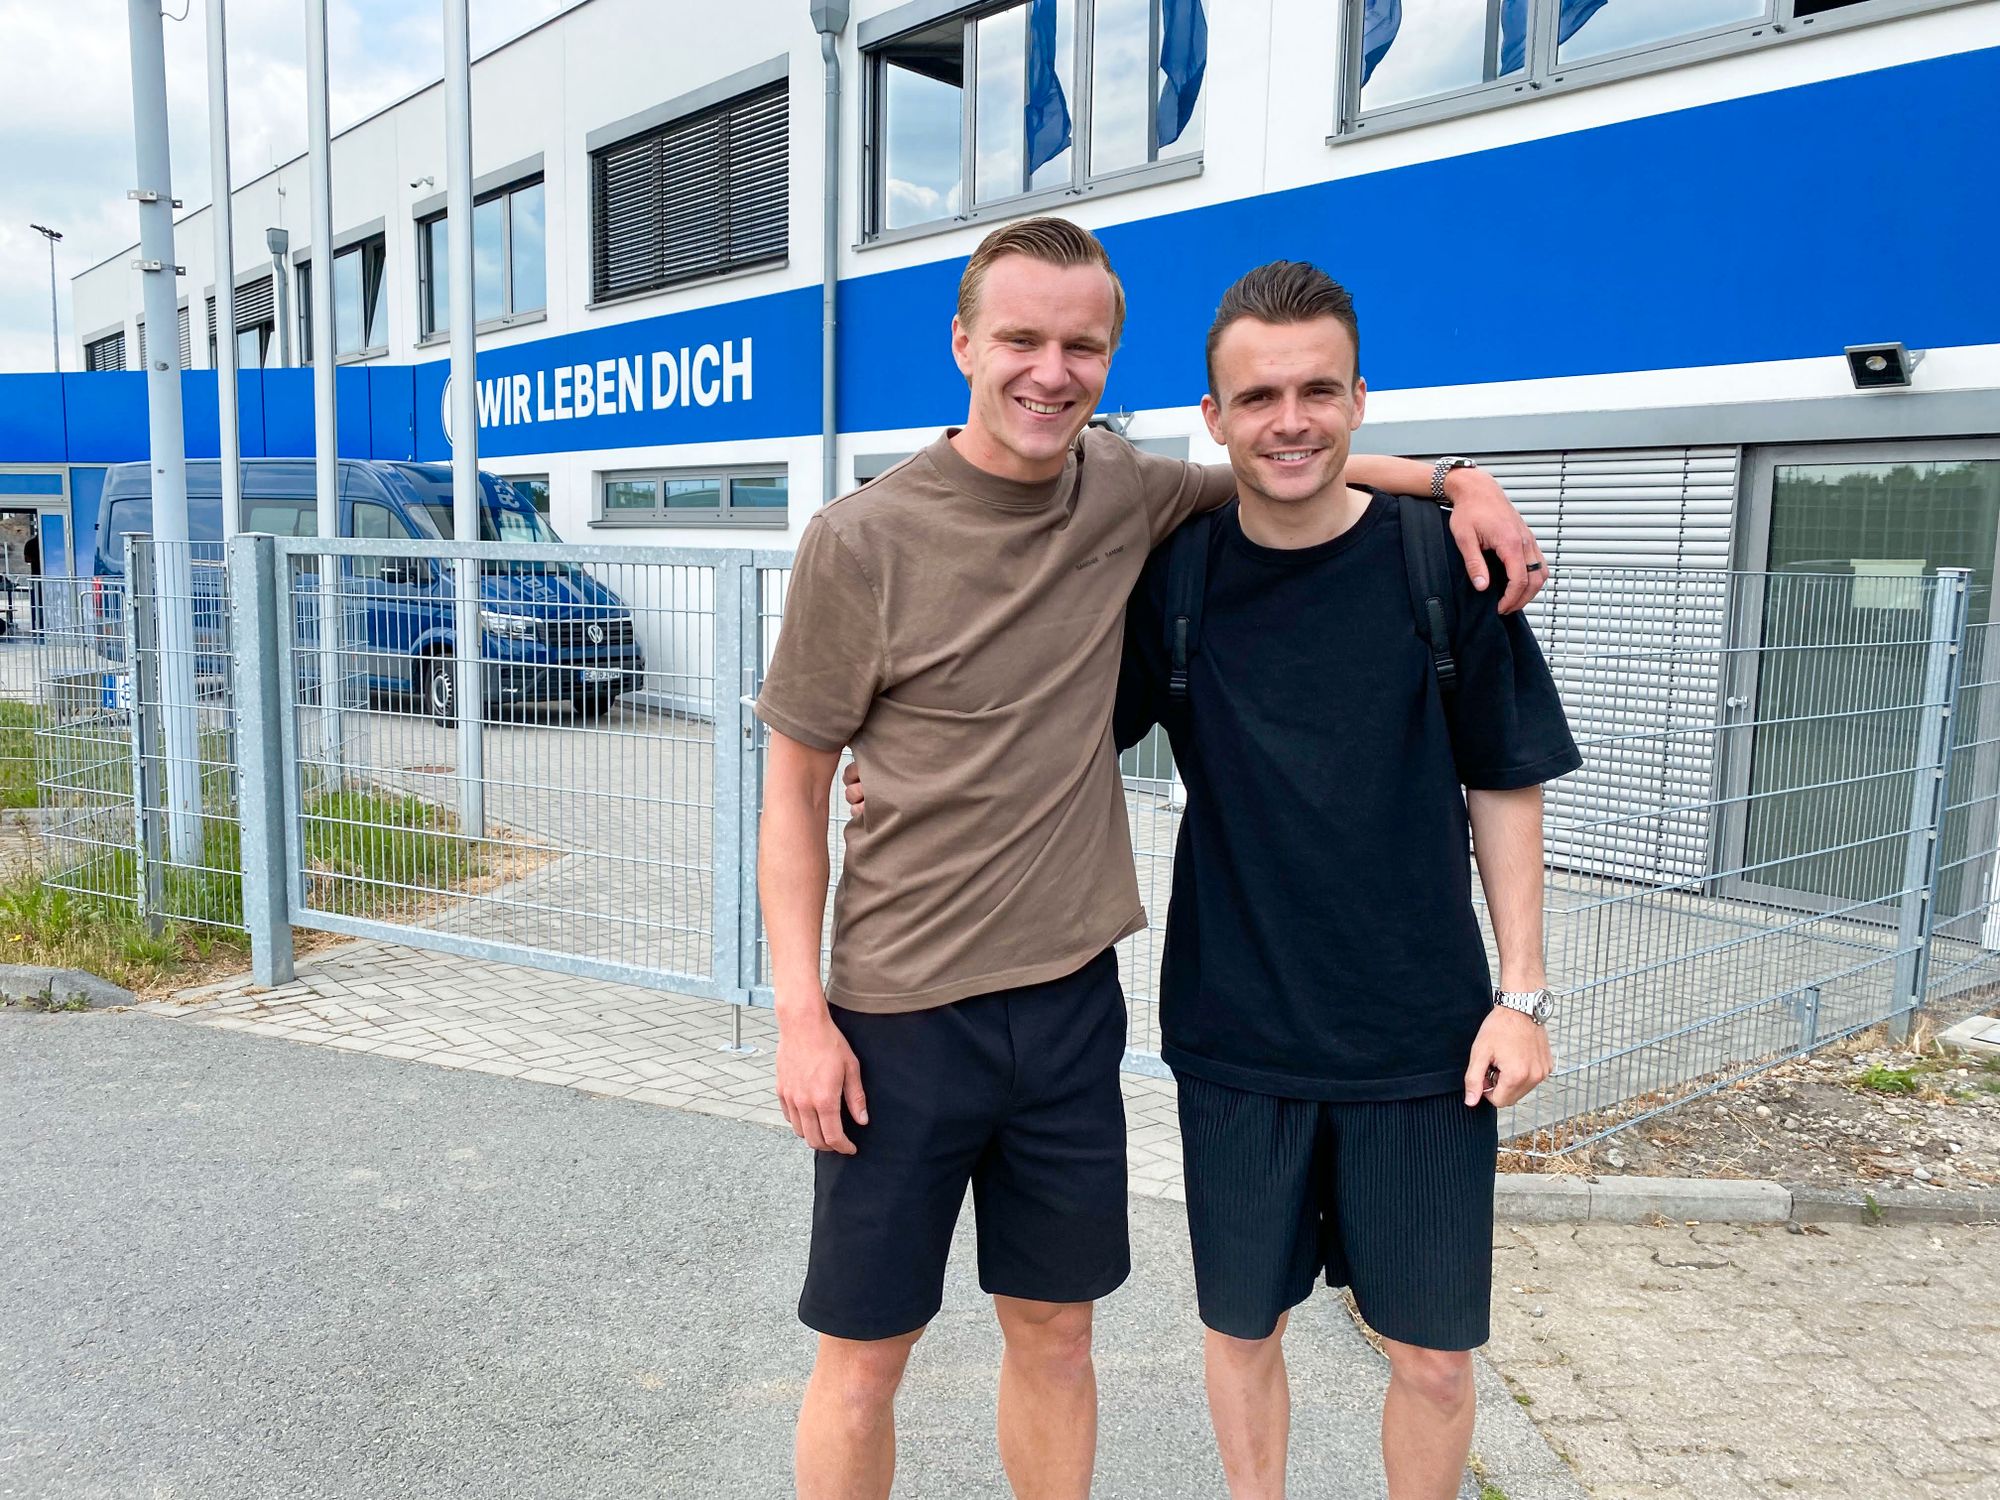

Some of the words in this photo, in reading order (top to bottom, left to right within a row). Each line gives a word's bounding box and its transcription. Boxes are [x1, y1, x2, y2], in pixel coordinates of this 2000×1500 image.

[475, 373, 532, 428] WIR
[537, 354, 644, 422] LEBEN
[652, 337, 753, 410] DICH
